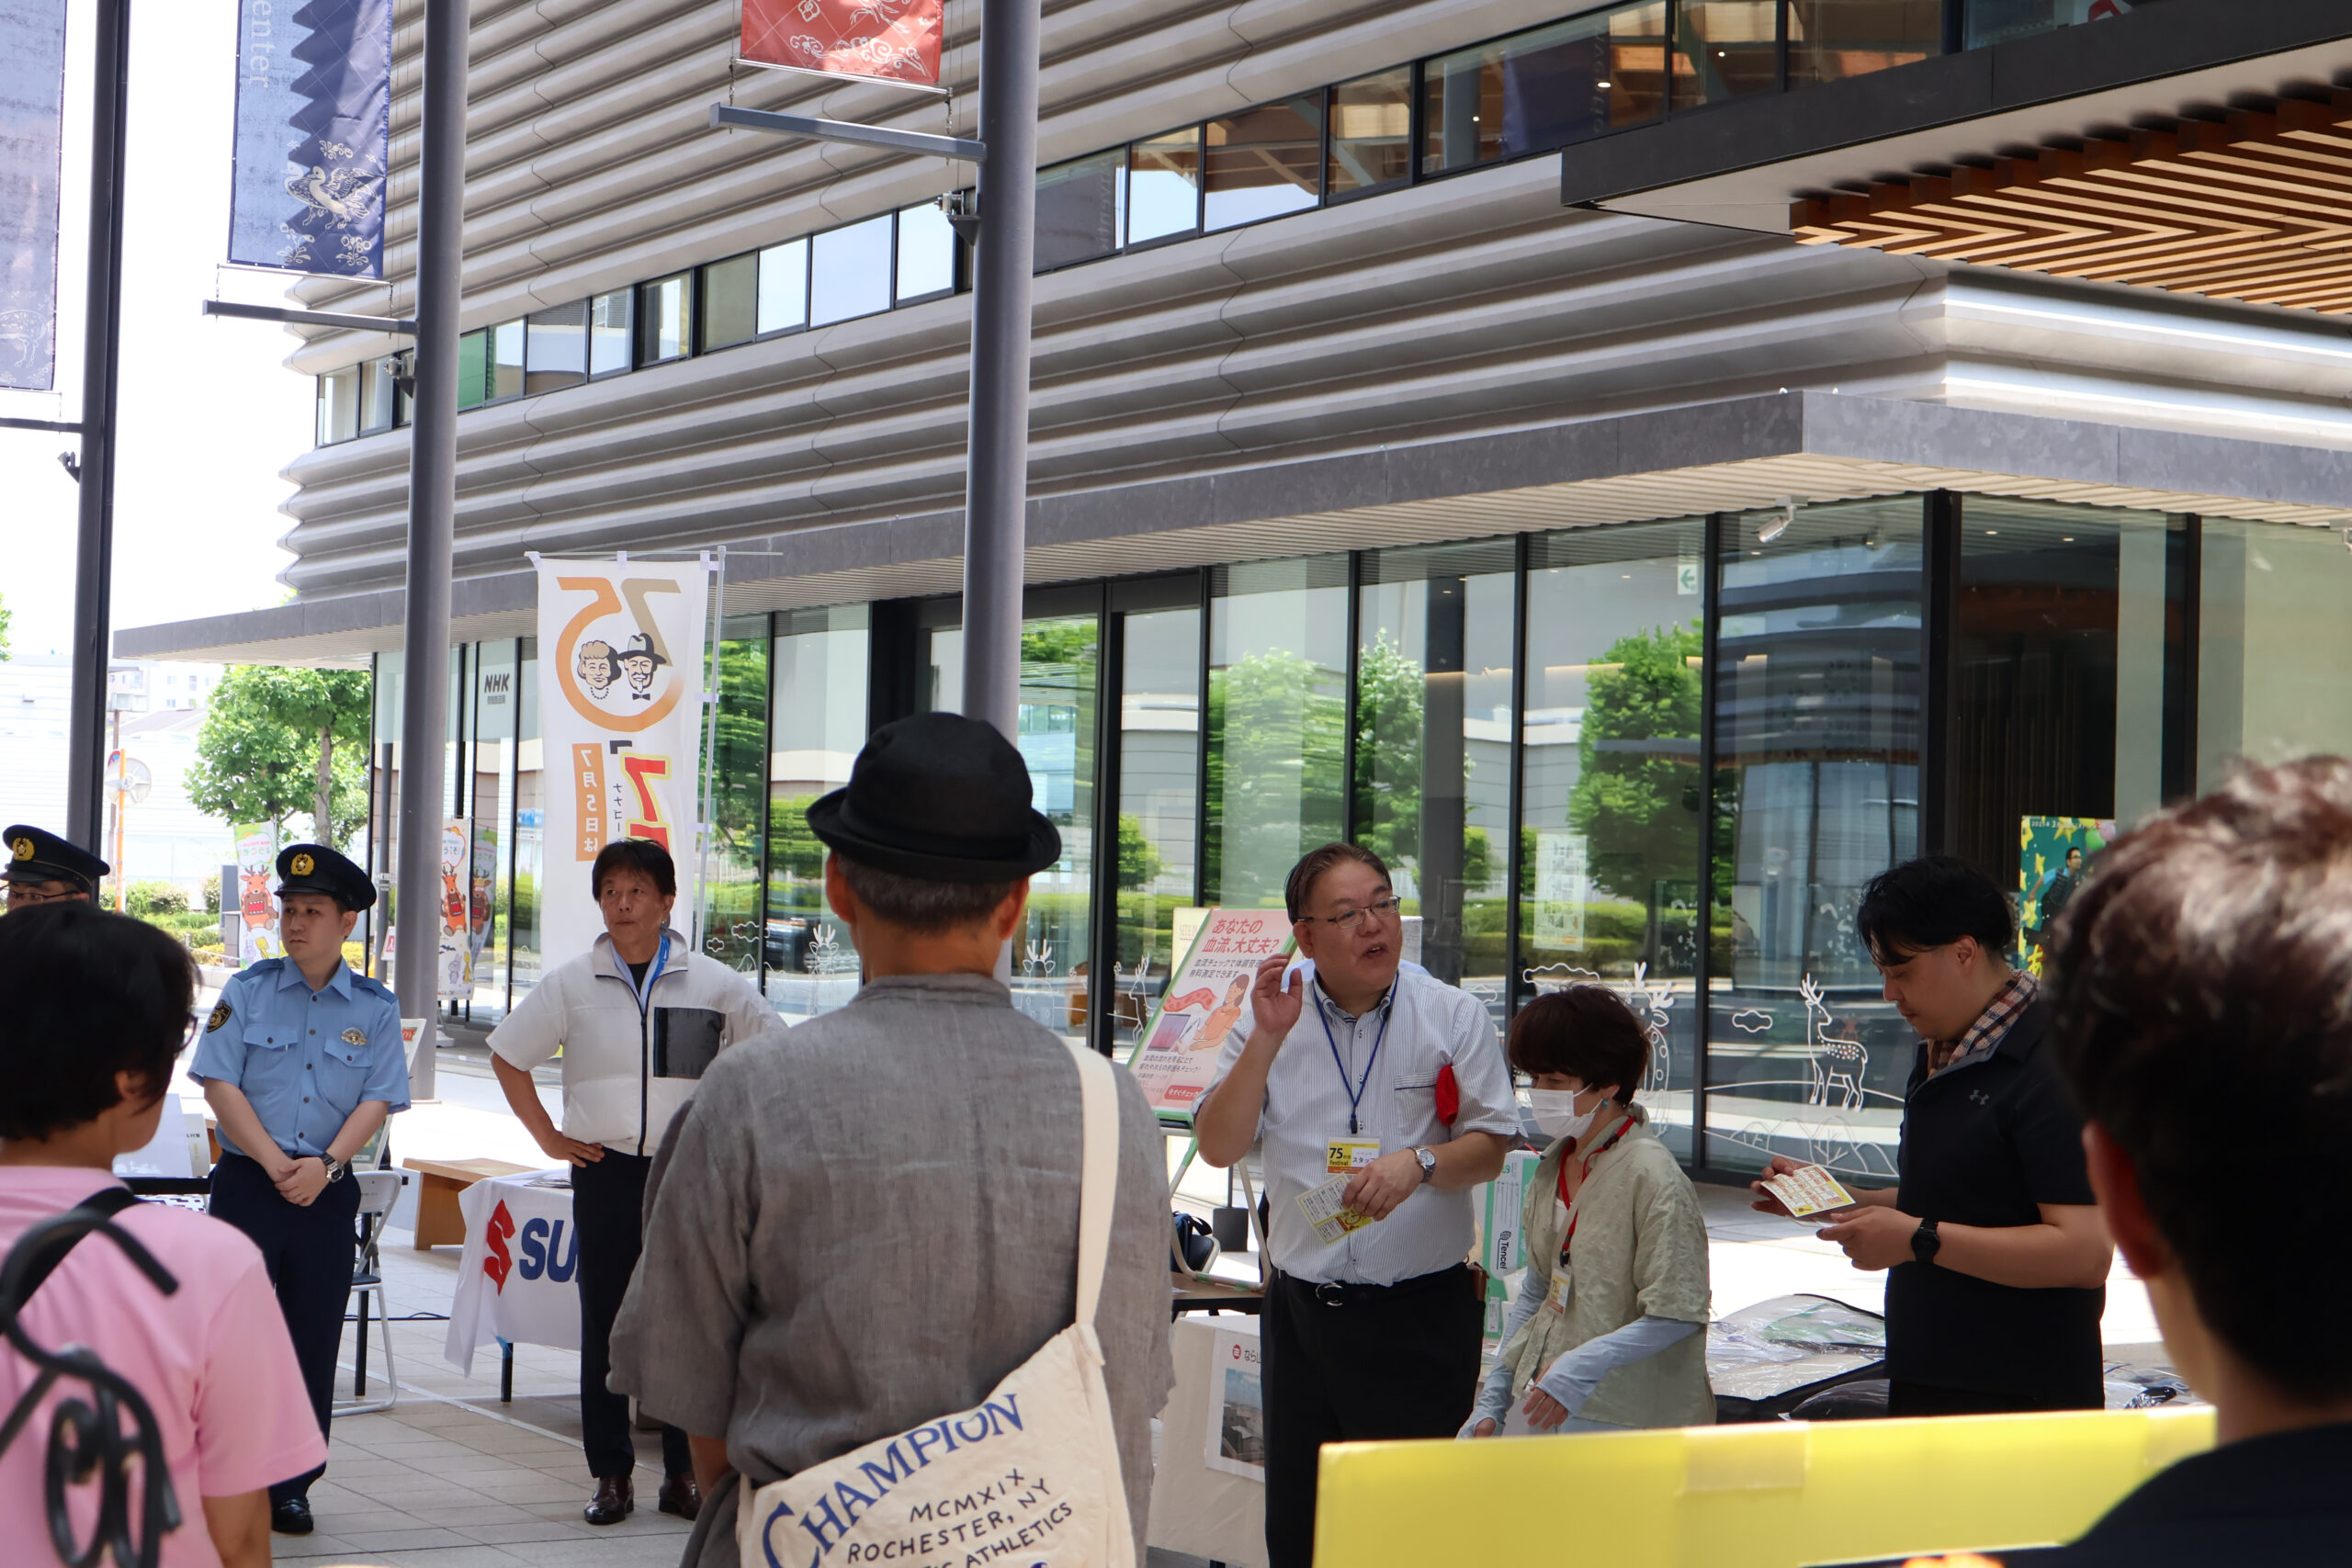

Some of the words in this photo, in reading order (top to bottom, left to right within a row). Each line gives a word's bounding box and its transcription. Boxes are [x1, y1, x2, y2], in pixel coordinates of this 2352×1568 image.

[249, 0, 276, 88] enter
[484, 672, 510, 694] NHK
[1212, 919, 1263, 935] あなたの
[518, 1217, 580, 1283] SU
[847, 1509, 1015, 1564] ROCHESTER,
[1017, 1477, 1051, 1509] NY
[910, 1468, 1025, 1523] MCMXIX
[965, 1501, 1073, 1568] ATHLETICS
